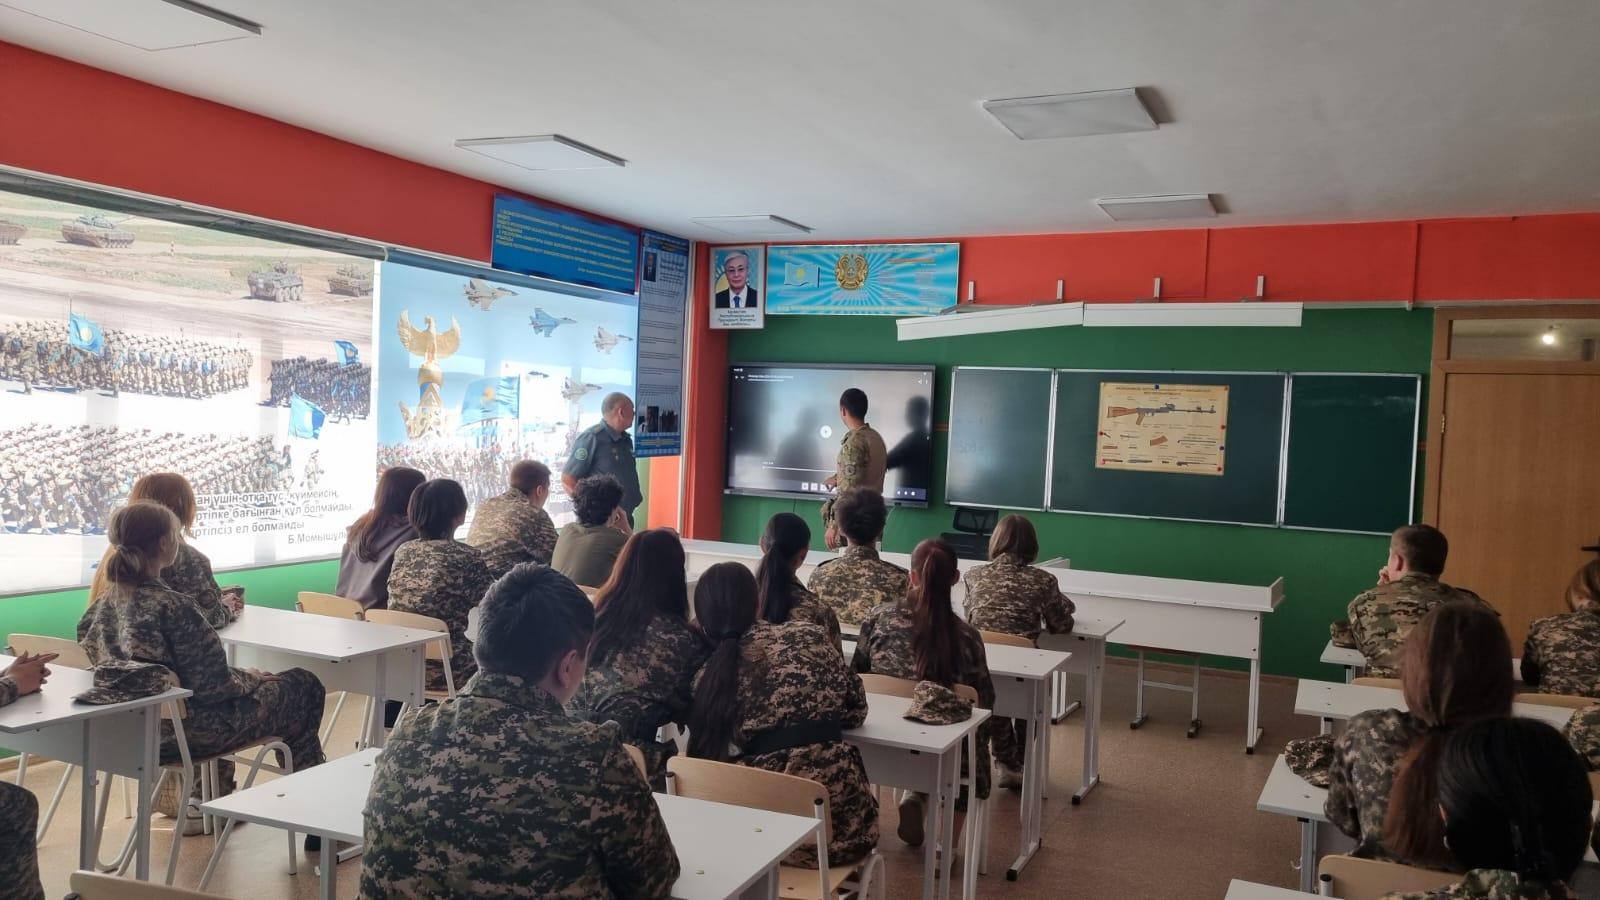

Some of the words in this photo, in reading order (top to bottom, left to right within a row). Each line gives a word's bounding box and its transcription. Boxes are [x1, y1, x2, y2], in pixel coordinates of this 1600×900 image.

[196, 509, 229, 522] ртіпке
[192, 525, 233, 537] ртіпсіз
[235, 525, 249, 534] ел
